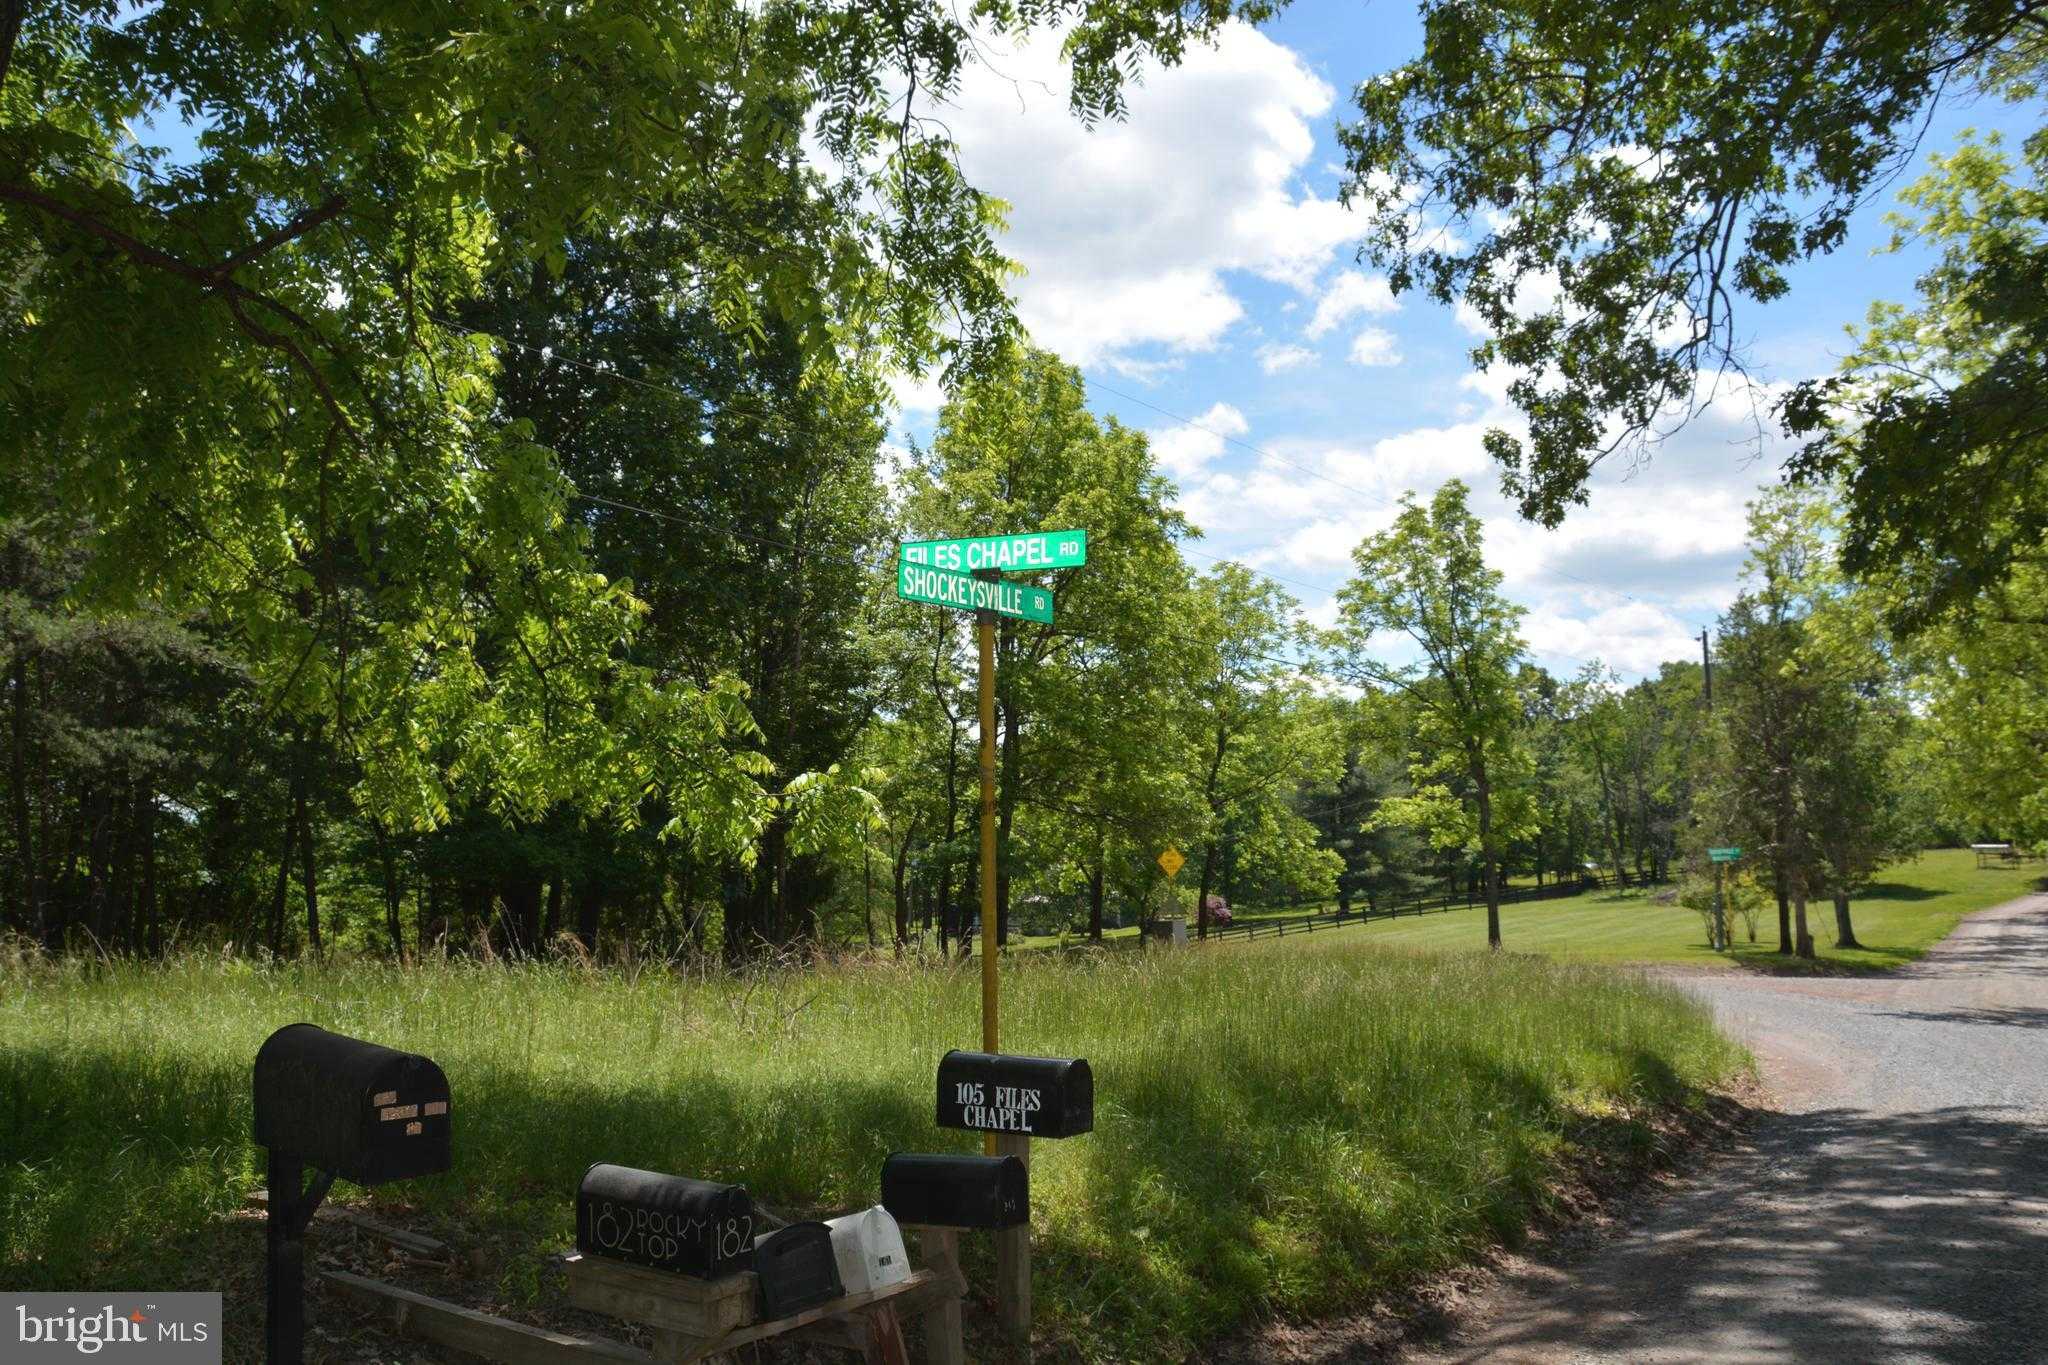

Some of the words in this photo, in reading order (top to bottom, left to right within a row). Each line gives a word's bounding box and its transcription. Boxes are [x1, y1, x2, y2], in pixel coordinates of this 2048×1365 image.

[967, 538, 1053, 569] CHAPEL
[1060, 541, 1079, 556] RD
[904, 567, 1023, 615] SHOCKEYSVILLE
[1034, 596, 1045, 610] RD
[955, 1083, 985, 1105] 105
[996, 1086, 1041, 1111] FILES
[963, 1105, 1032, 1132] CHAPEL
[588, 1202, 634, 1252] 182
[716, 1215, 752, 1260] 182
[637, 1231, 678, 1261] TOP
